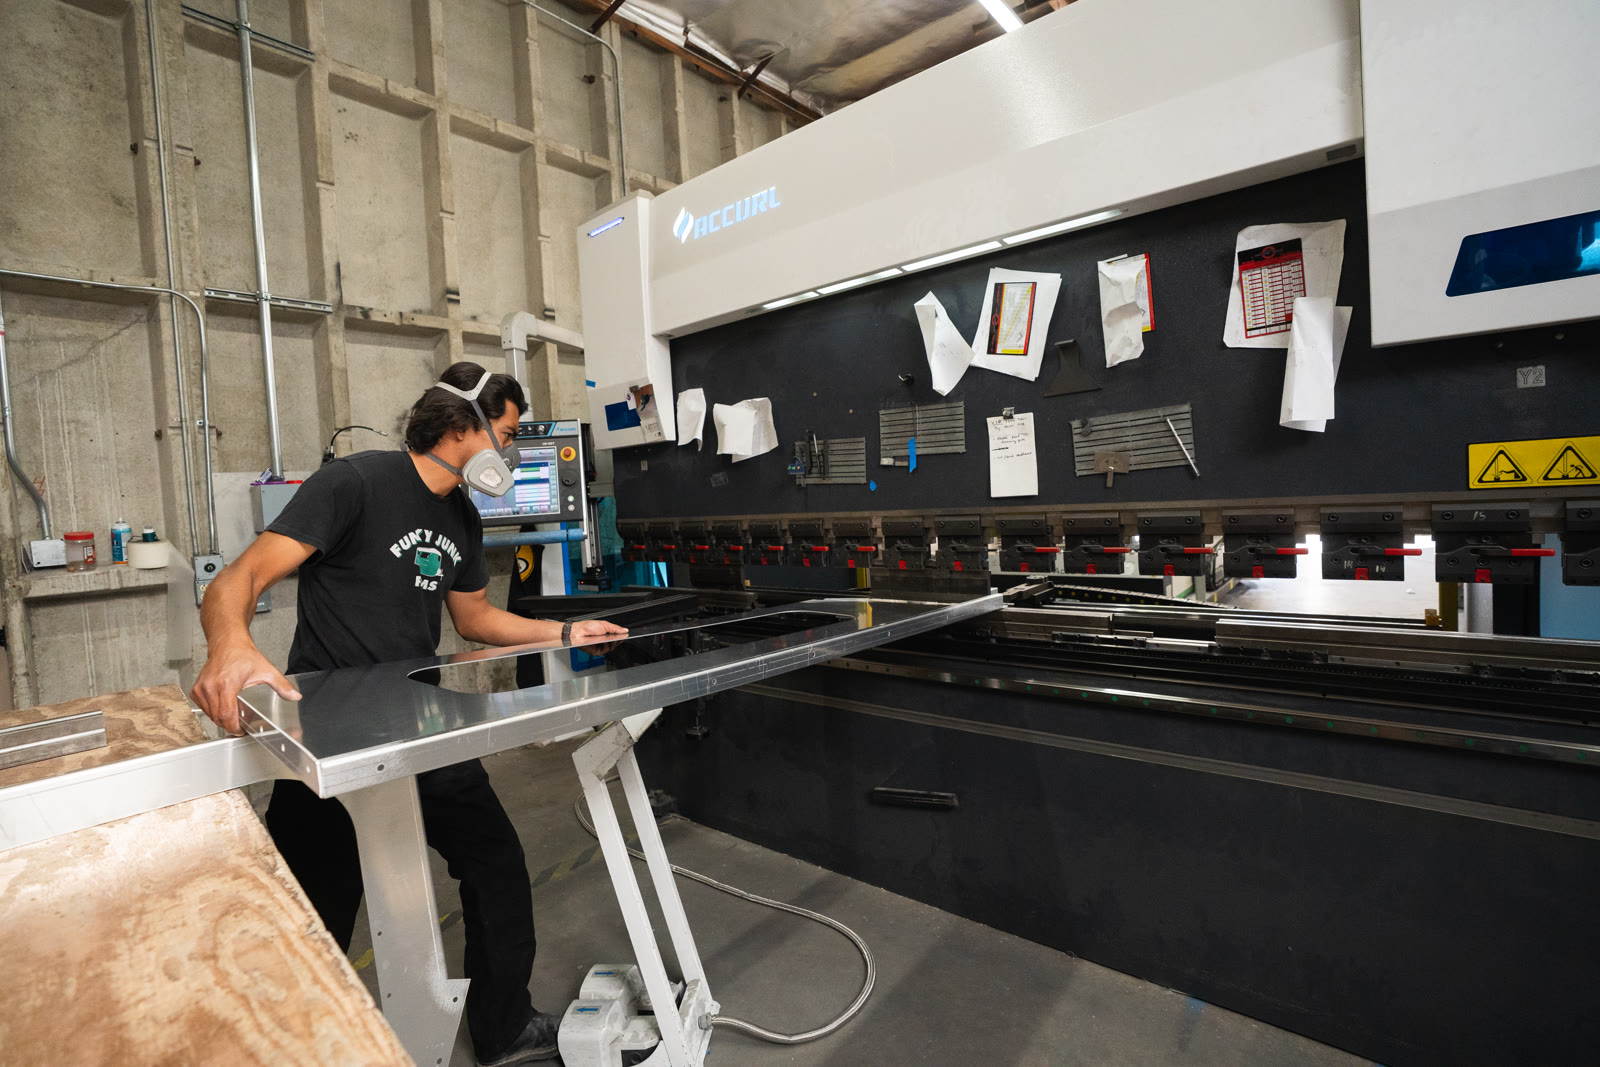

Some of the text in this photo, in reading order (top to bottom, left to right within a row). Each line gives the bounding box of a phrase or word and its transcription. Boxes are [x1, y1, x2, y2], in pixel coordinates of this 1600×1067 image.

[693, 186, 781, 240] ACCURL
[1518, 367, 1544, 385] Y2
[389, 528, 462, 567] FUNKY JUNK
